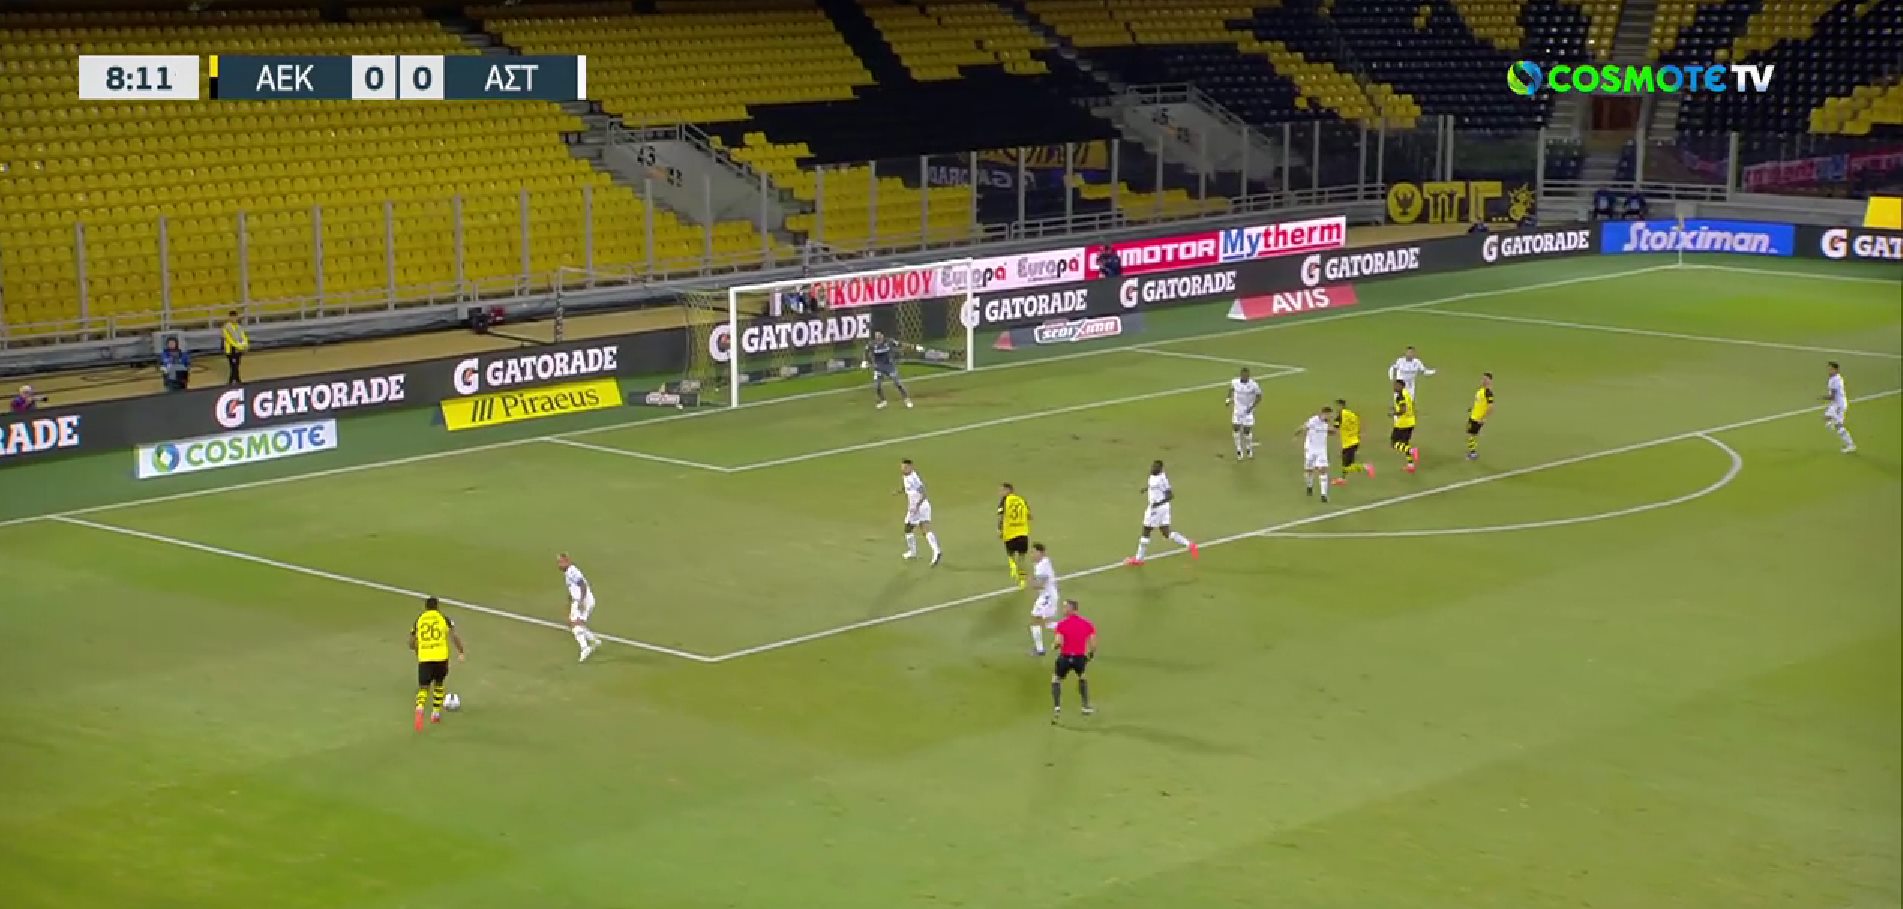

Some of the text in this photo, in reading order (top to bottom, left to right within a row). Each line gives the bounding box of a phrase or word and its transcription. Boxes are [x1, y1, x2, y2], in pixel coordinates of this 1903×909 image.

[1222, 221, 1342, 259] Mytherm
[1501, 230, 1591, 257] GATORADE
[1622, 222, 1771, 252] Stoiximan
[1325, 247, 1421, 280] GATORADE
[1142, 271, 1237, 301] GATORADE
[1272, 288, 1330, 313] AVIS
[985, 289, 1088, 322] GATORADE
[742, 313, 872, 353] GATORADE
[486, 346, 618, 386] GATORADE
[253, 374, 405, 418] GATORADE
[501, 387, 600, 417] Piraeus
[186, 425, 326, 467] COSMOTE
[421, 621, 441, 641] 26
